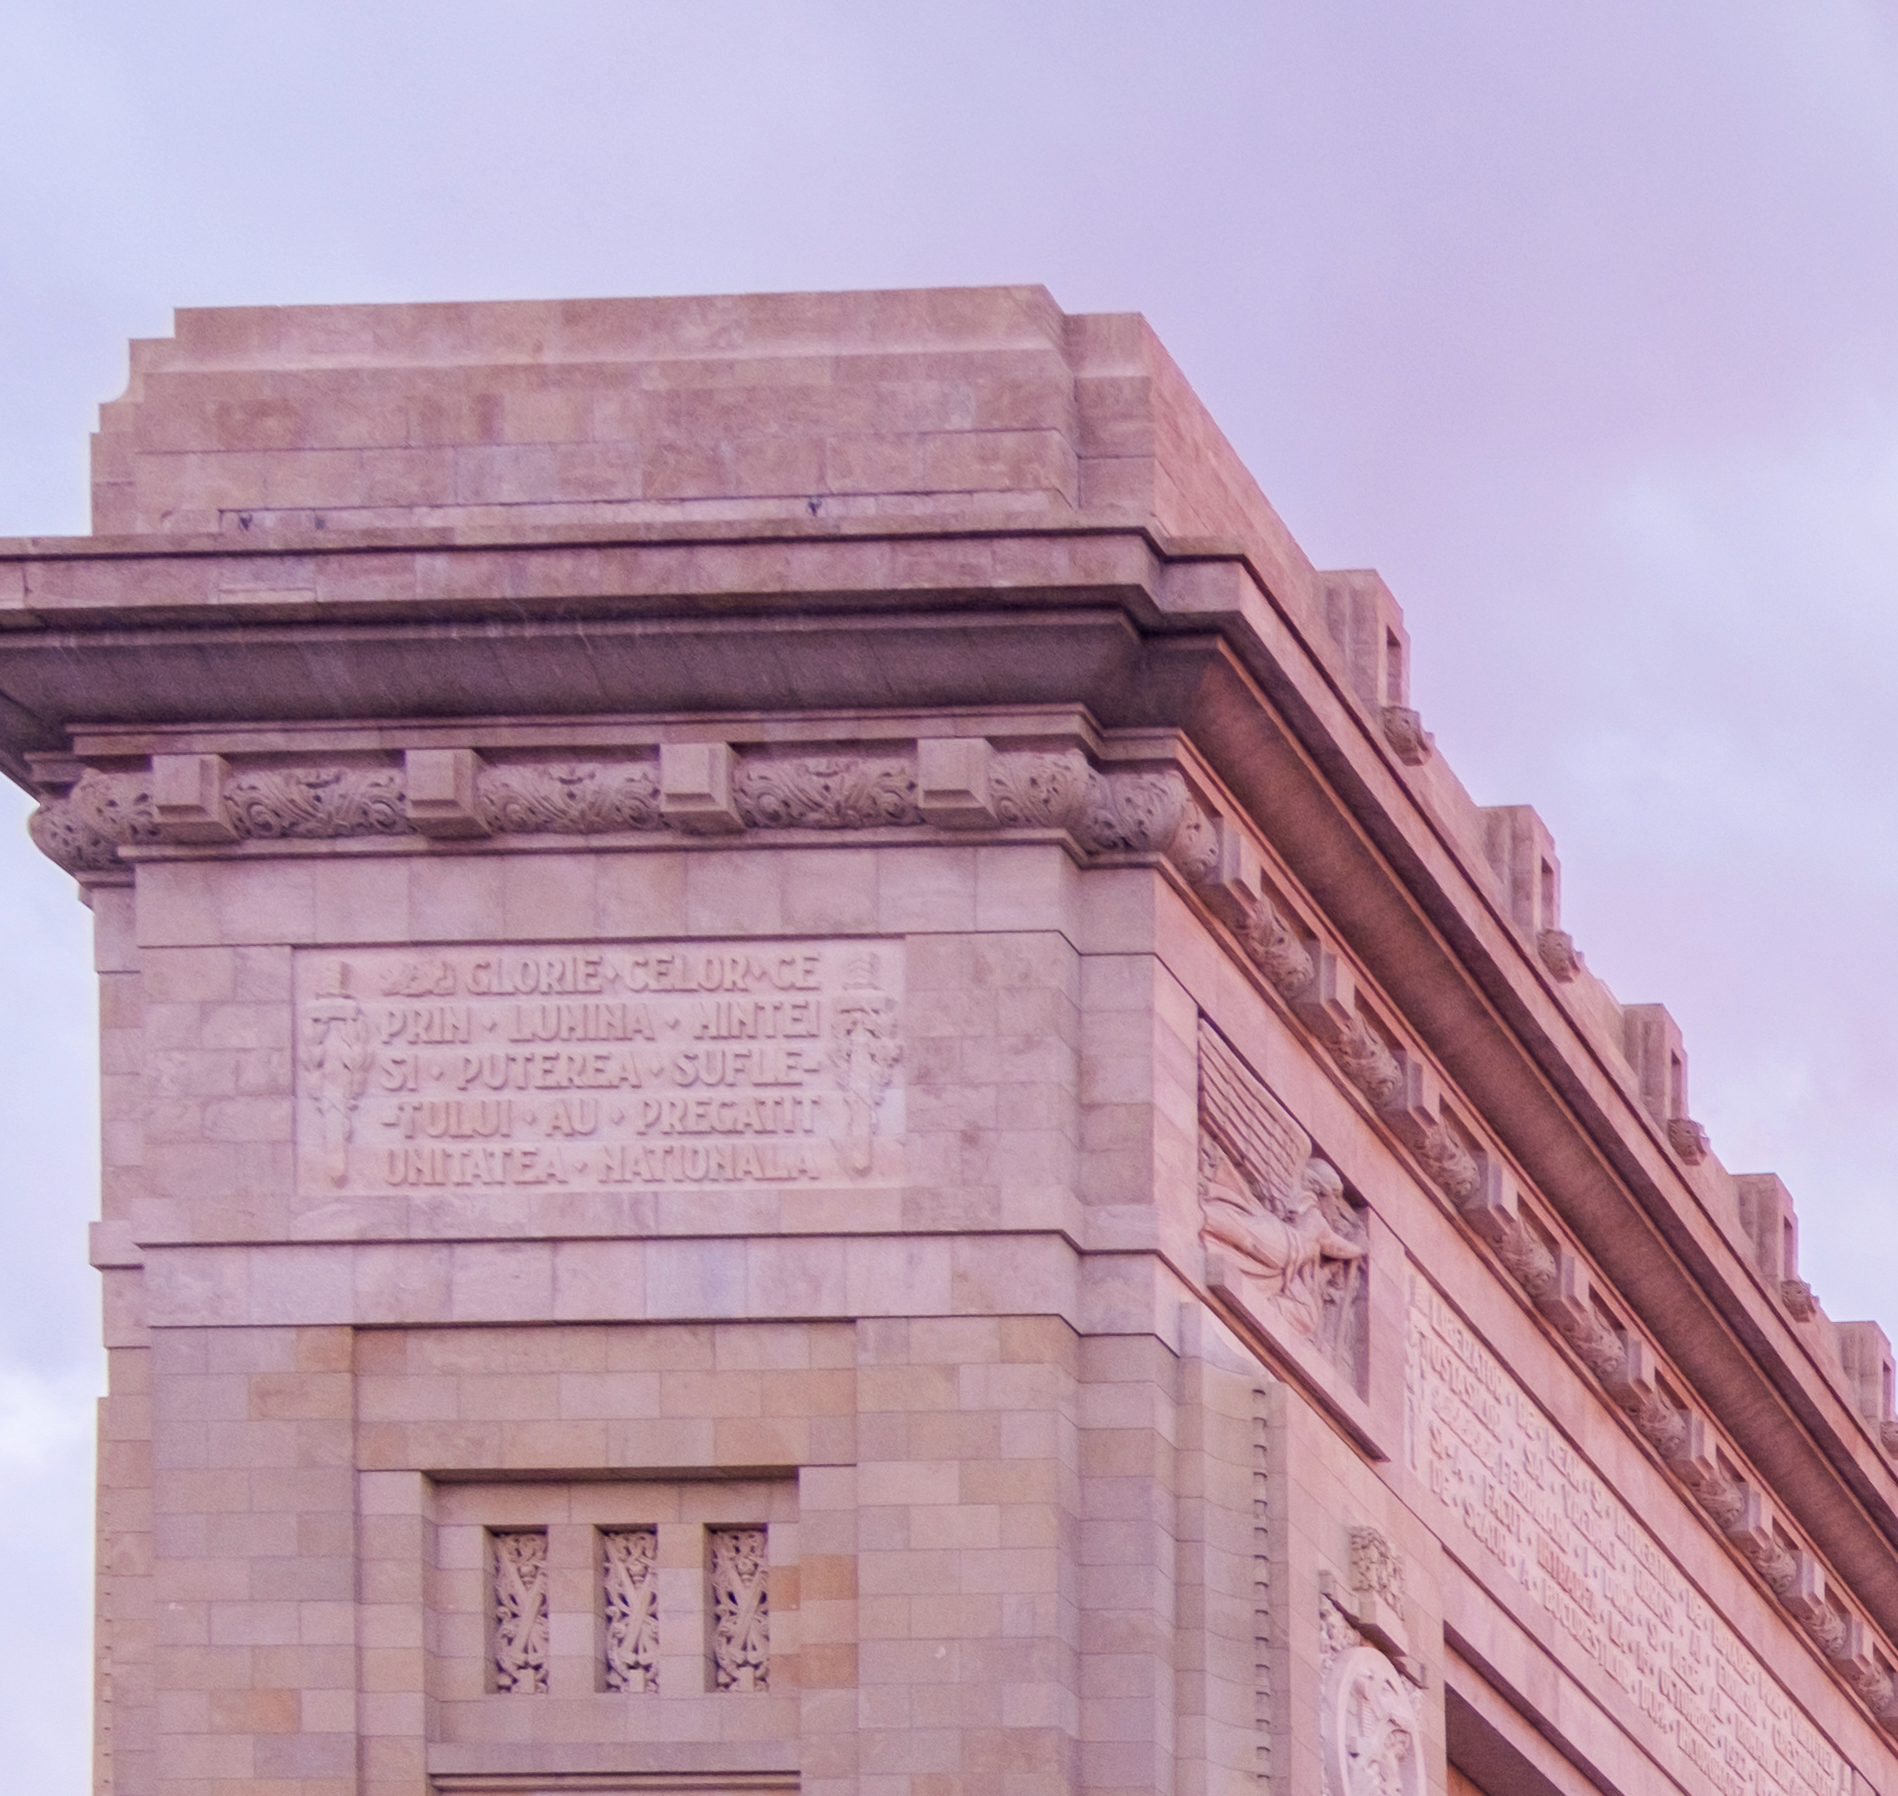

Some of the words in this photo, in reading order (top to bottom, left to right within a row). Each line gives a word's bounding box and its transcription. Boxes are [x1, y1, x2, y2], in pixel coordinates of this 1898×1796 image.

[466, 958, 602, 994] GLORIE
[624, 956, 750, 992] CELOR
[770, 956, 822, 991] CE
[382, 1008, 470, 1044] PRIN
[382, 1056, 417, 1091] SI
[457, 1052, 642, 1090] PUTEREA
[546, 1101, 598, 1136] AU
[387, 1149, 569, 1185] UNITATEA
[599, 1145, 819, 1182] NATIONALA
